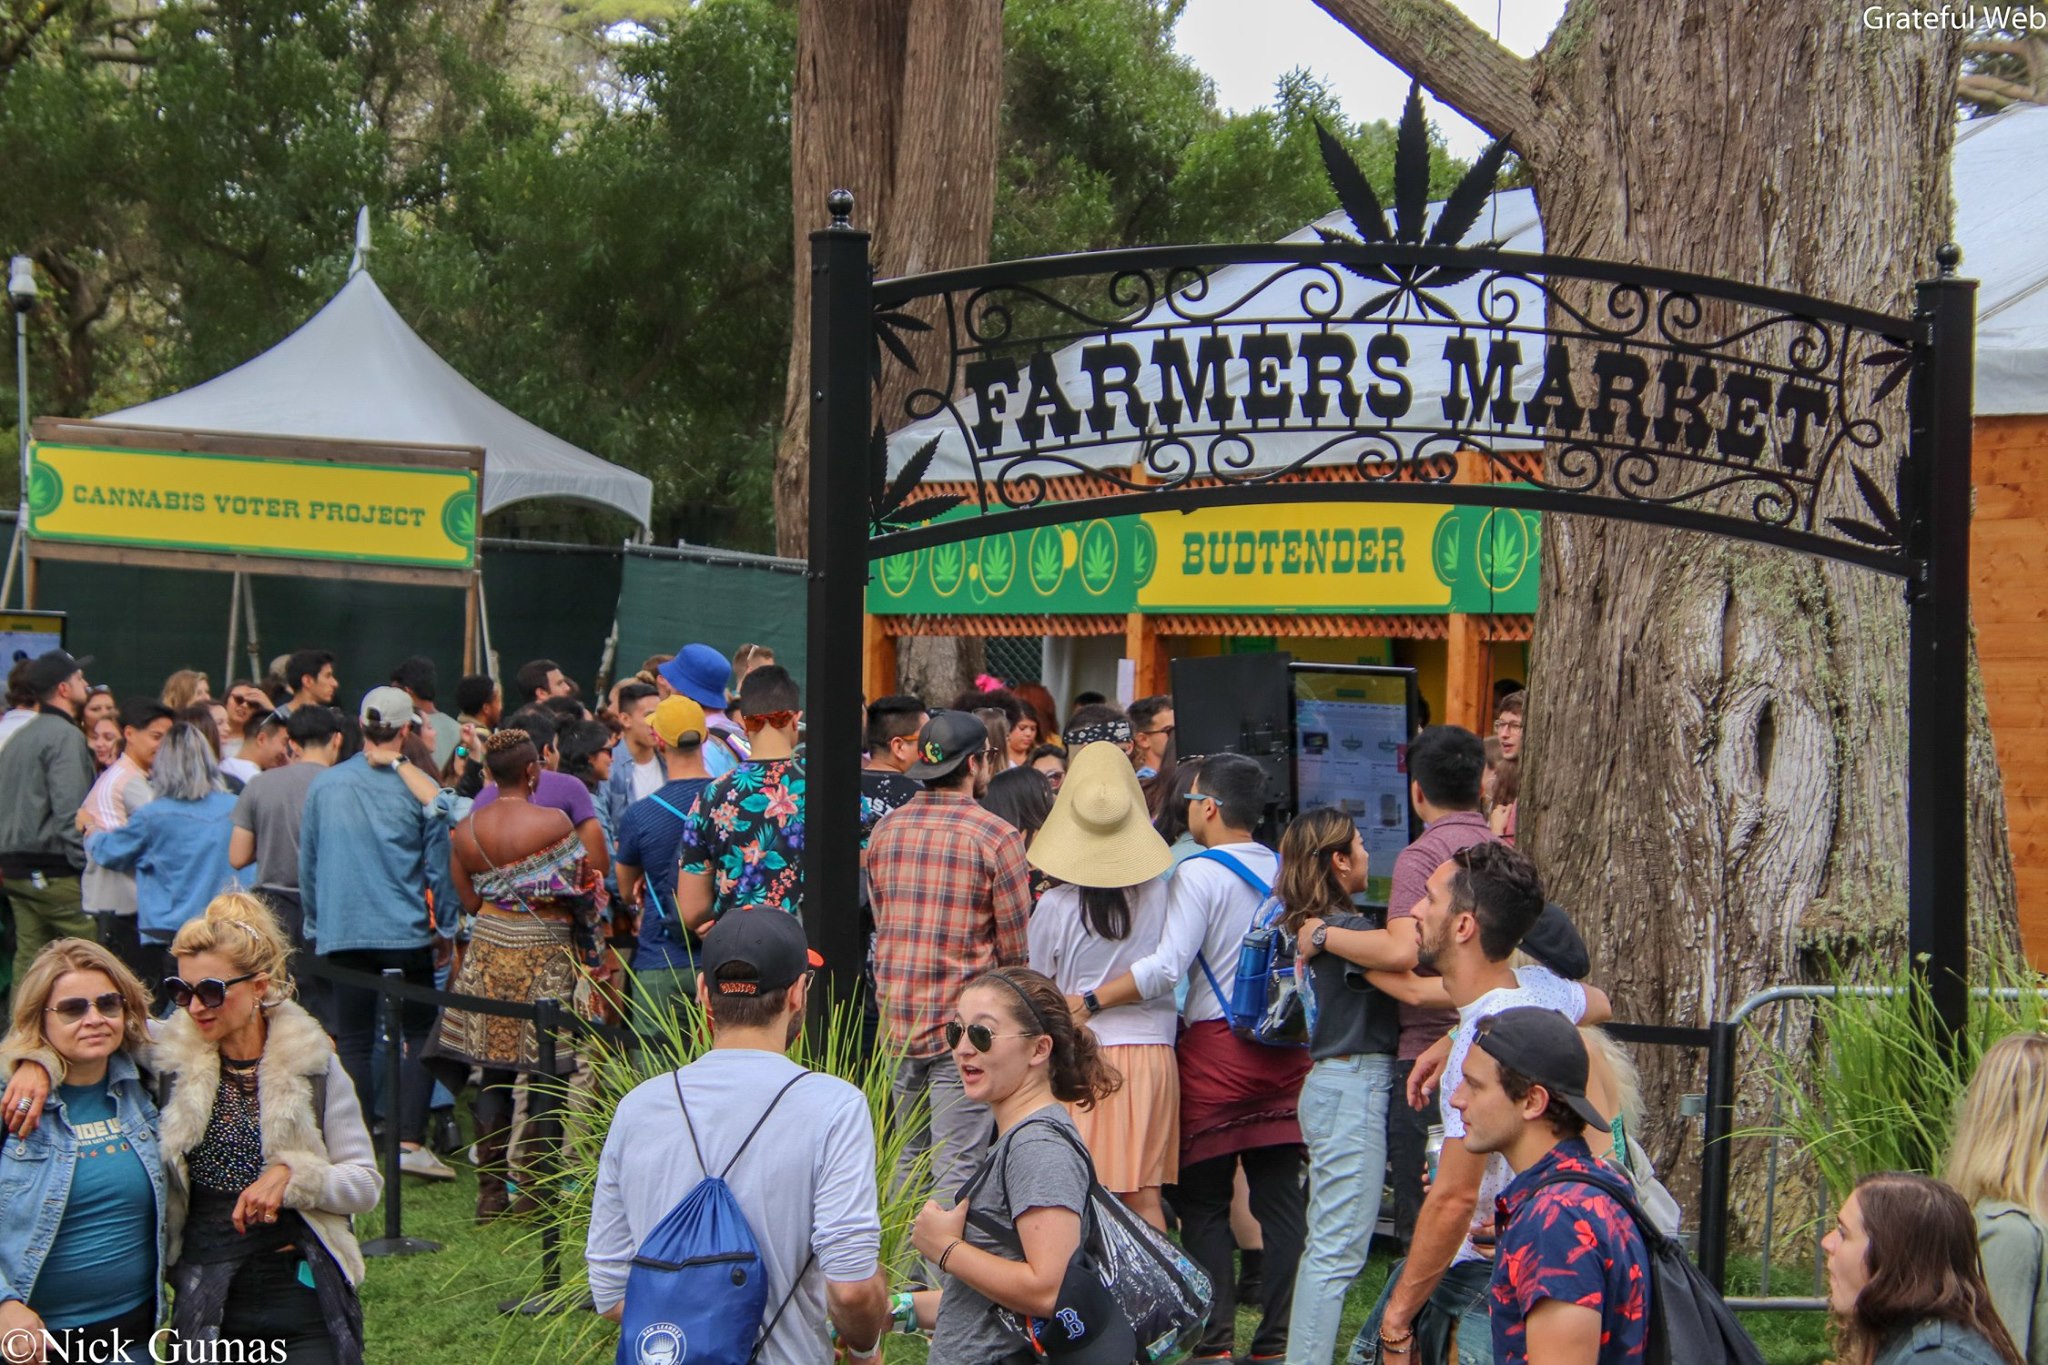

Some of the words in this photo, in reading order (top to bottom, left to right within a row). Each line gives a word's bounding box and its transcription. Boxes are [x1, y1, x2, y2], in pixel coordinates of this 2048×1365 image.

[965, 332, 1414, 448] FARMERS
[1441, 335, 1831, 467] MARKET
[73, 484, 206, 512] CANNABIS
[214, 495, 300, 519] VOTER
[308, 501, 425, 527] PROJECT
[1182, 527, 1406, 575] BUDTENDER
[1056, 1307, 1085, 1339] B
